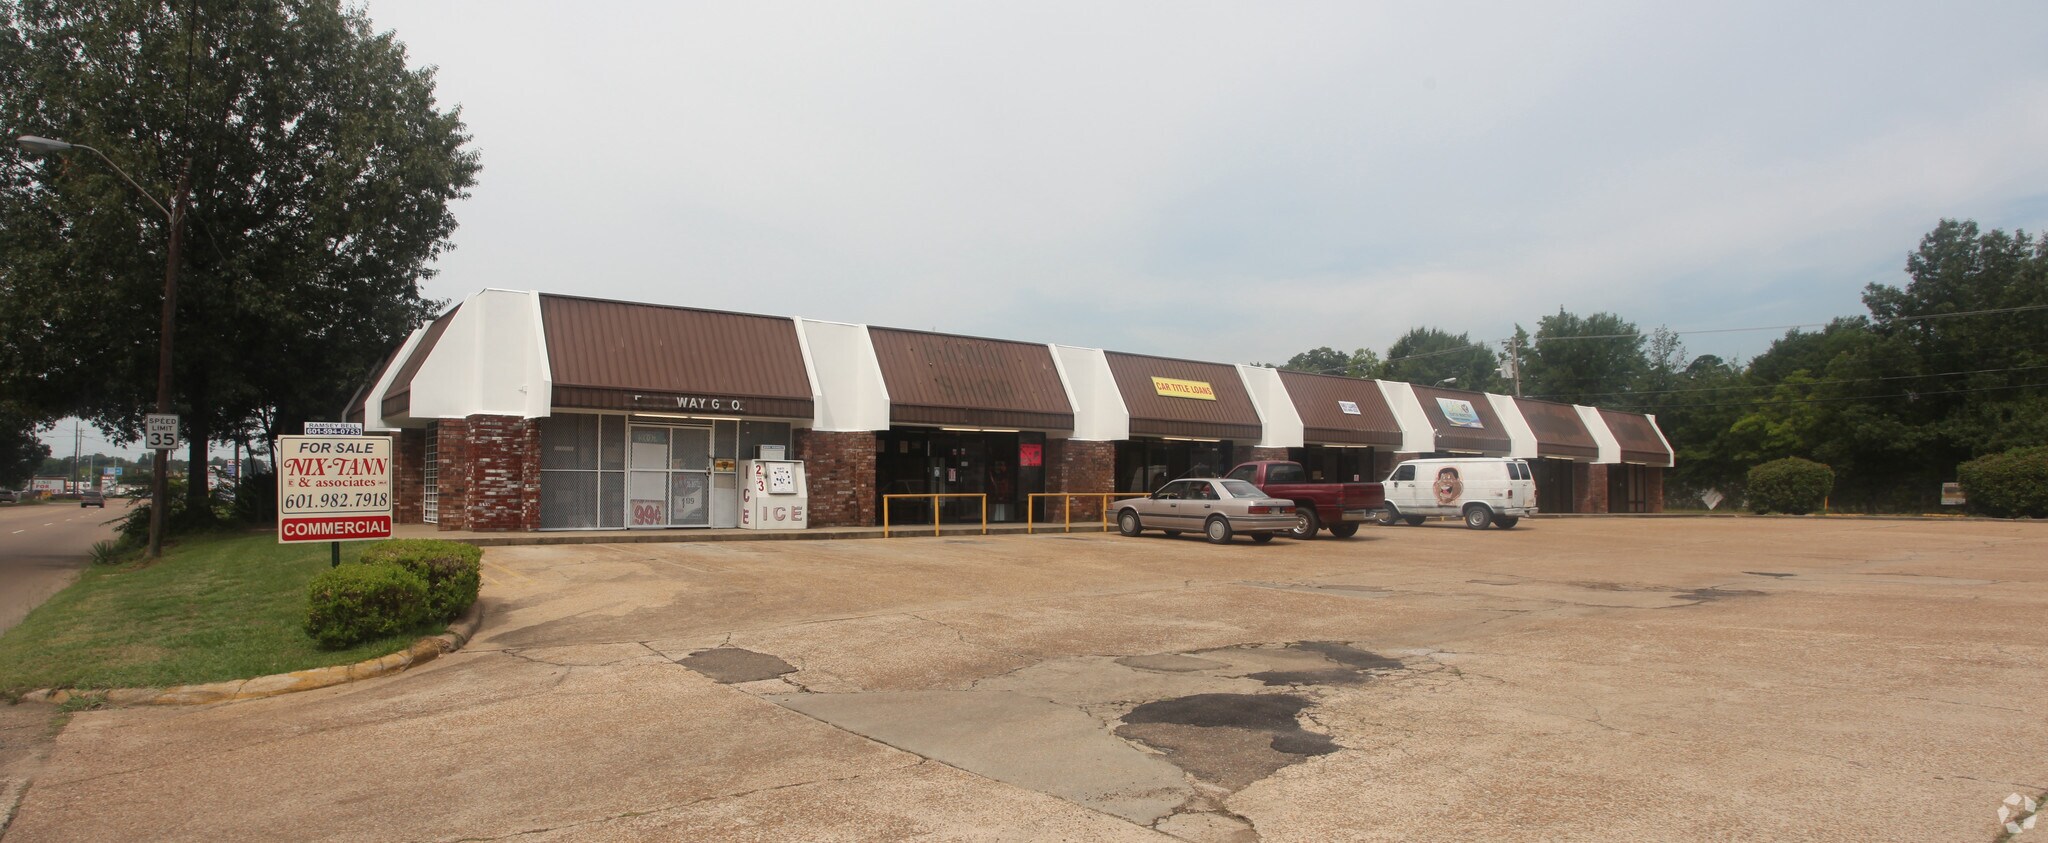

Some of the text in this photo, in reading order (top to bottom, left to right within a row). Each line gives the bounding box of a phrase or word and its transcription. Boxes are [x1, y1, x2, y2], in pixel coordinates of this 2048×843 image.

[1156, 381, 1212, 395] CAR TITLE LOANS
[677, 397, 706, 409] WAY
[149, 417, 177, 425] SPEED
[150, 432, 175, 446] 35
[299, 442, 375, 454] FOR SALE
[284, 457, 388, 476] NIX-TANN
[298, 477, 312, 488] &
[315, 476, 376, 487] associates
[285, 492, 388, 509] 601.982.7918
[763, 505, 803, 522] ICE
[283, 520, 390, 537] COMMERCIAL
